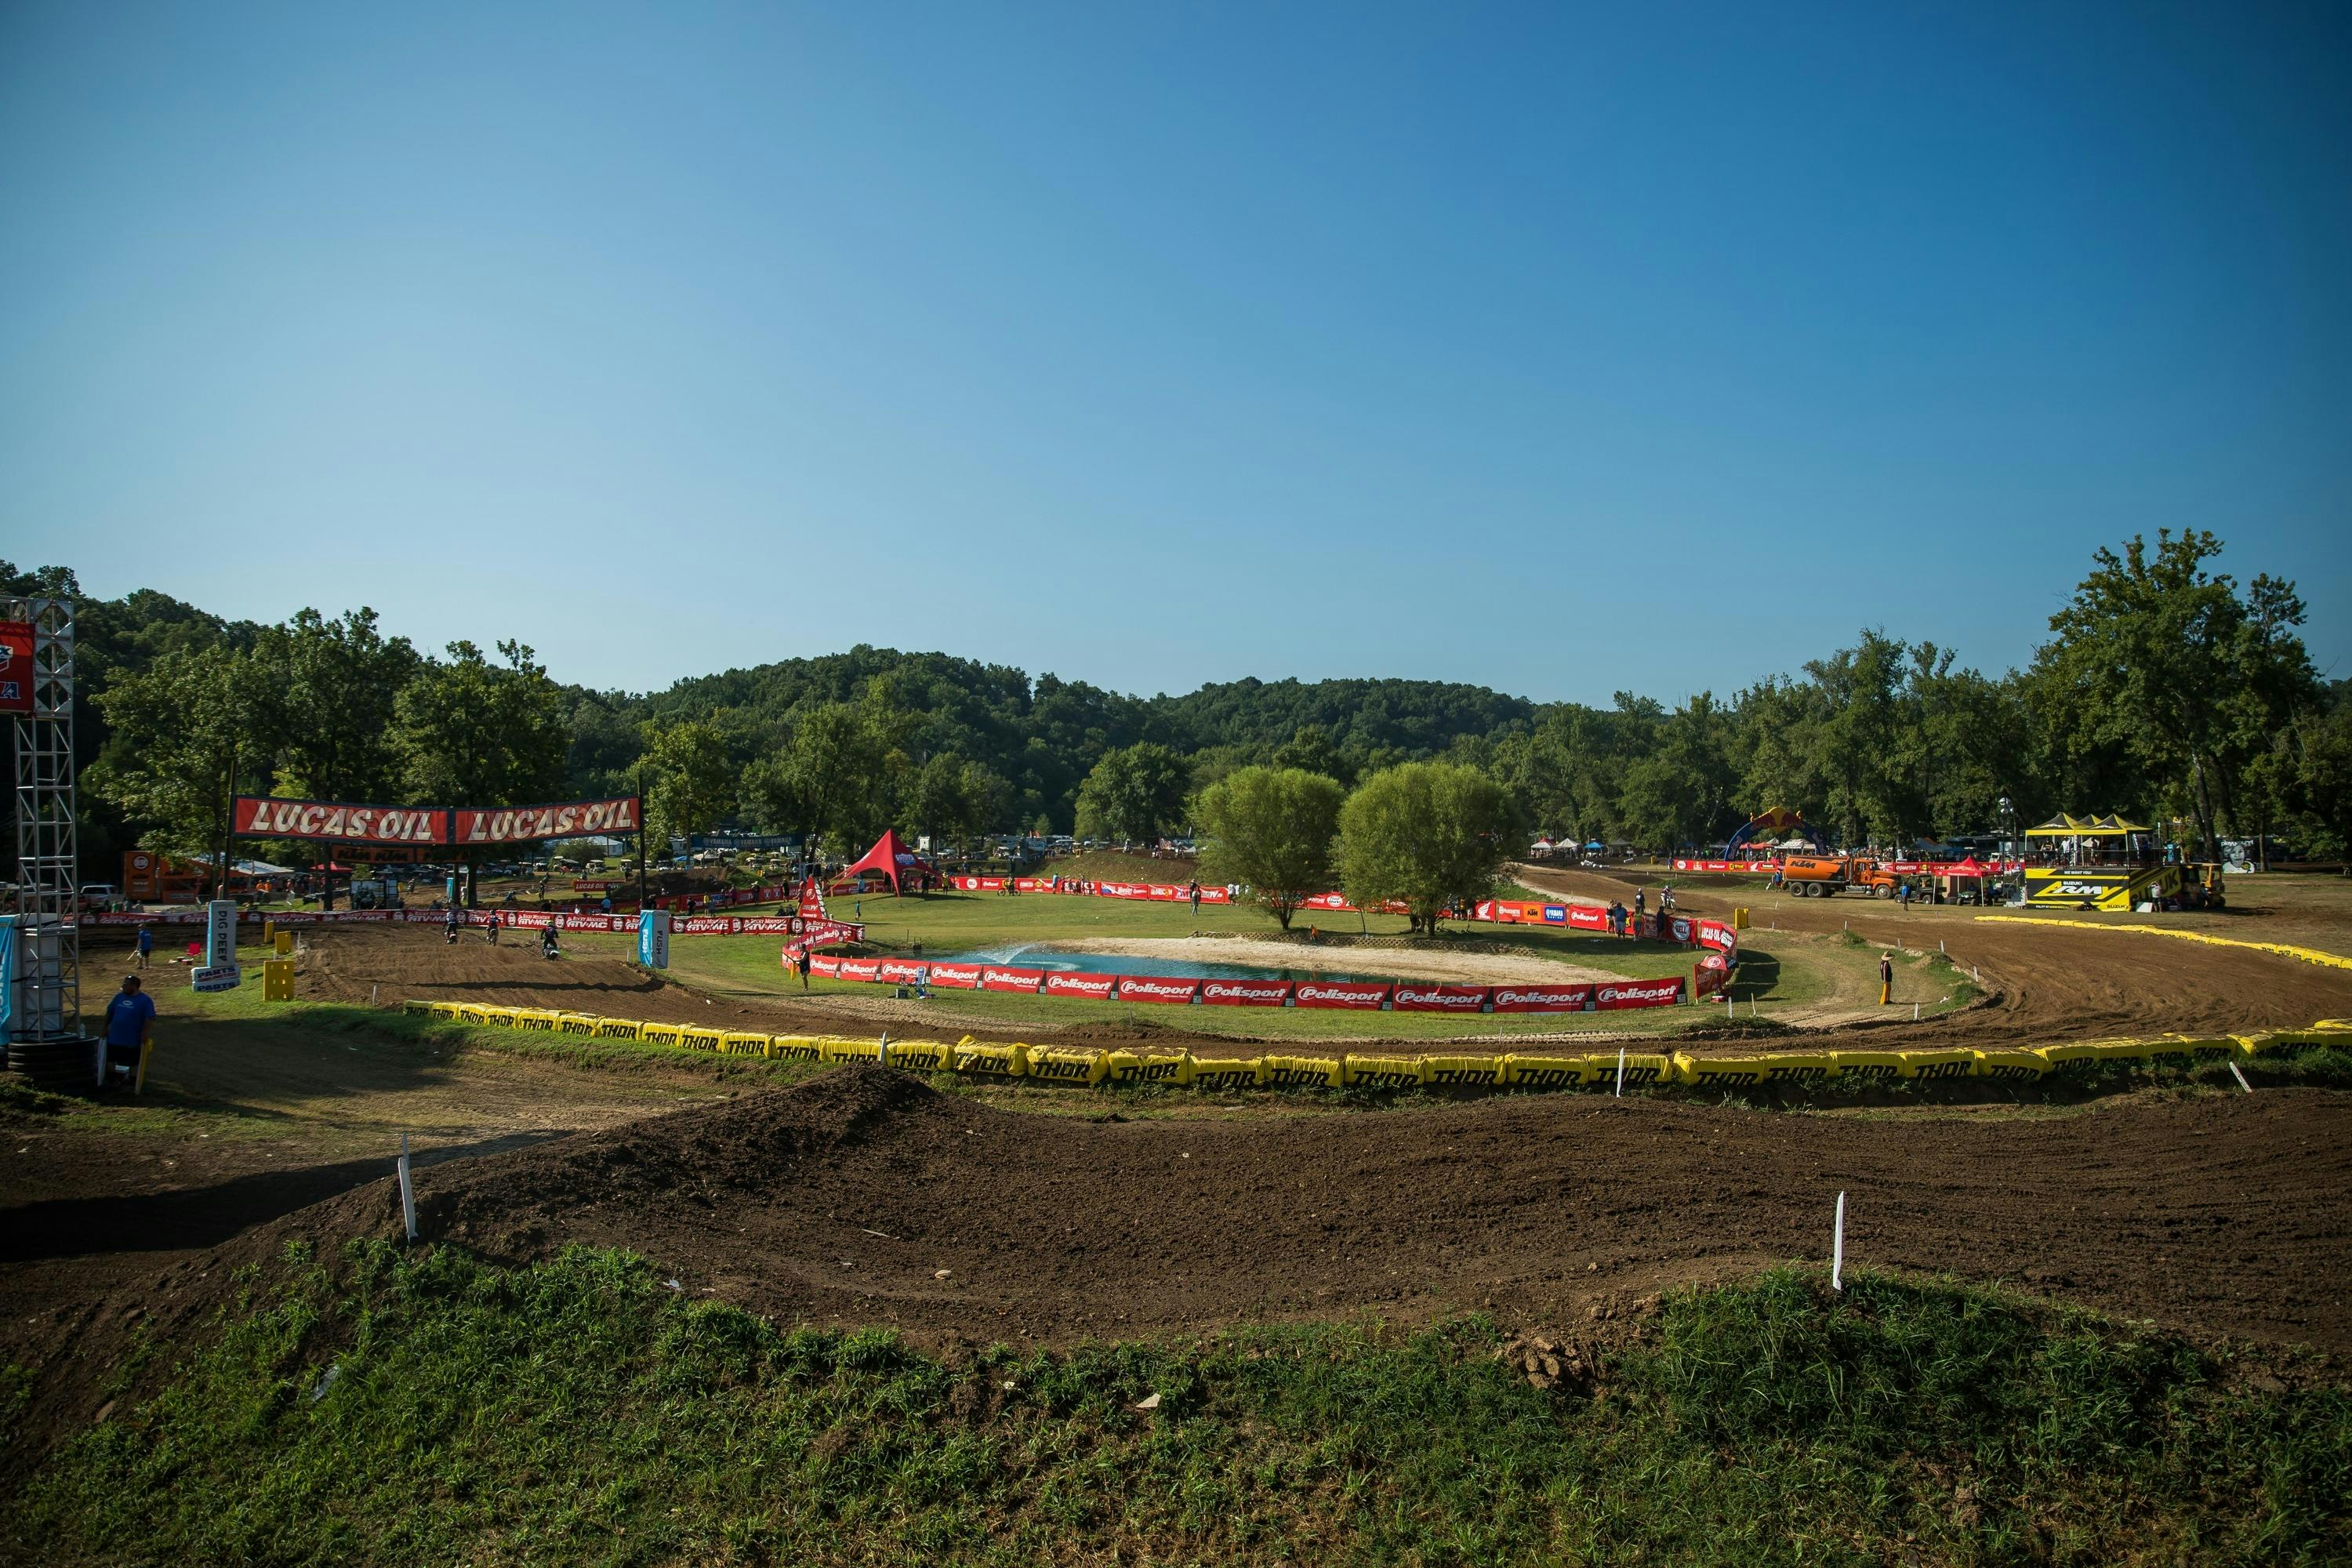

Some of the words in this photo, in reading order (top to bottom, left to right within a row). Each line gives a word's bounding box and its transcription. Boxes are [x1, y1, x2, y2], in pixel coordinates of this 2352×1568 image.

[249, 801, 372, 837] LUCAS
[377, 811, 432, 840] OIL
[468, 806, 576, 840] LUCAS
[583, 800, 633, 831] OIL
[1790, 860, 1817, 869] KTM
[2033, 880, 2123, 900] ARMY
[218, 910, 228, 929] DIG
[1573, 912, 1599, 922] Polisport
[1675, 925, 1687, 934] BELL
[1701, 927, 1713, 941] LUCAS
[217, 932, 228, 961] DEEP
[198, 966, 235, 978] PARTS
[811, 959, 837, 971] Polisport
[844, 964, 877, 974] Polisport
[933, 967, 979, 980] Polisport
[986, 972, 1040, 985] Polisport
[198, 982, 236, 991] PARTS
[1051, 977, 1111, 991] Polisport
[1123, 982, 1194, 995] Polisport
[1207, 985, 1287, 998] Polisport
[1301, 988, 1384, 1002] Polisport
[1399, 992, 1483, 1005] Polisport
[1501, 991, 1587, 1004] Polisport
[1601, 985, 1678, 1003] Polisport
[433, 1009, 454, 1019] THOR
[459, 1010, 485, 1025] THOR
[488, 1014, 514, 1026] THOR
[522, 1018, 554, 1030] THOR
[561, 1021, 593, 1034] THOR
[601, 1024, 637, 1040] THOR
[645, 1032, 677, 1045] THOR
[681, 1034, 719, 1051] THOR
[728, 1040, 765, 1054] THOR
[777, 1046, 821, 1060] THOR
[891, 1053, 941, 1068] THOR
[955, 1051, 1009, 1073] THOR
[2053, 1056, 2096, 1071] THOR
[1033, 1062, 1091, 1079] THOR
[1118, 1062, 1179, 1080] THOR
[1515, 1068, 1582, 1085] THOR
[1596, 1066, 1661, 1083] THOR
[1768, 1067, 1828, 1080] THOR
[1838, 1065, 1897, 1078] THOR
[1914, 1060, 1973, 1079] THOR
[1991, 1065, 2040, 1080] THOR
[1195, 1070, 1257, 1086] THOR
[1270, 1068, 1330, 1086] THOR
[1353, 1070, 1420, 1087] THOR
[1433, 1069, 1497, 1085] THOR
[1697, 1071, 1759, 1086] THOR
